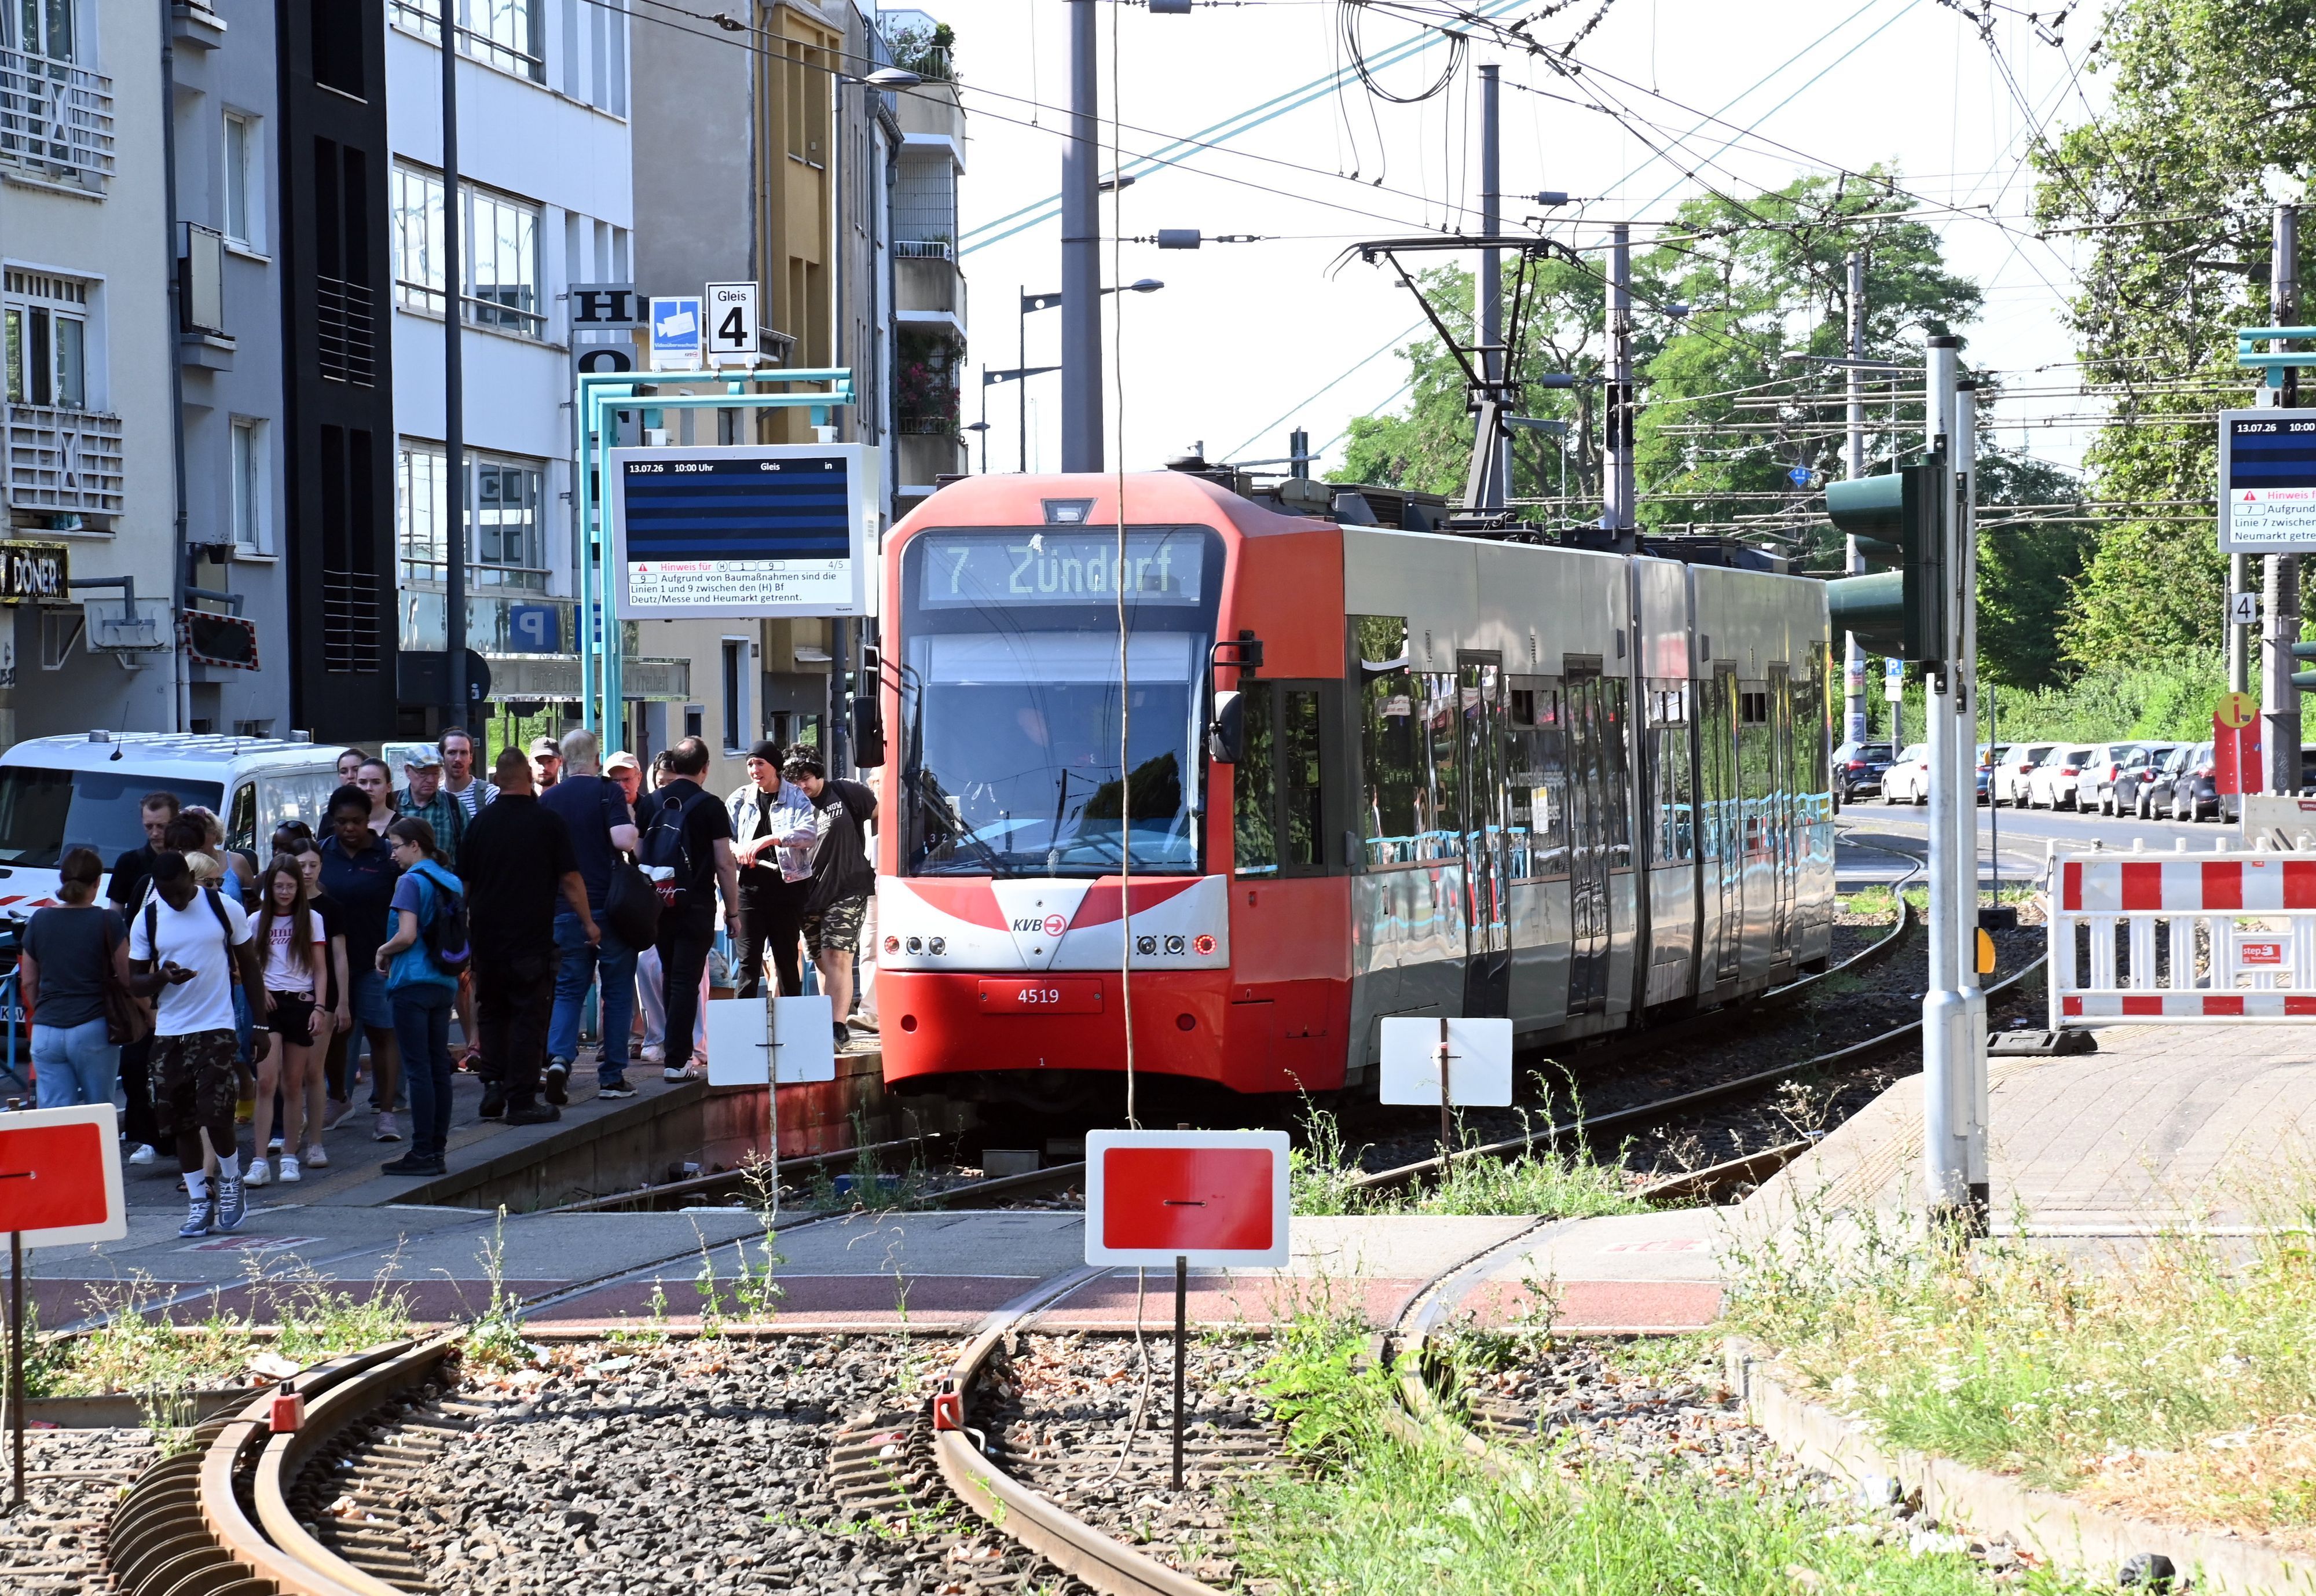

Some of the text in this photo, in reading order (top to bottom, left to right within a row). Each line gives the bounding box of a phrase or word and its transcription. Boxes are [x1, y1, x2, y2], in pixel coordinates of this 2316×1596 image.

[717, 290, 746, 302] Gleis
[719, 307, 747, 347] 4
[2237, 423, 2315, 432] 13.07.26 10:00
[629, 463, 713, 473] 13.07.26 10:00 Uhr
[760, 462, 780, 471] Gleis
[824, 461, 833, 470] in
[2267, 491, 2308, 500] Hinweis
[2247, 504, 2315, 515] 7 Aufgrund
[2235, 518, 2259, 527] Linie
[2263, 518, 2268, 526] 7
[2235, 531, 2286, 540] Neumarkt
[661, 563, 696, 571] Hinweis
[699, 562, 712, 571] für
[741, 563, 745, 571] 1
[768, 562, 774, 571] 9
[828, 560, 844, 570] 4/5
[947, 544, 1172, 594] 7 Zündorf
[640, 575, 646, 584] 9
[661, 574, 703, 584] Aufgrund
[725, 573, 799, 582] Baumaßnahmen
[801, 572, 820, 580] sind
[823, 572, 836, 580] die
[631, 585, 658, 593] Linien
[668, 585, 685, 593] und
[696, 584, 736, 592] zwischen
[739, 584, 756, 592] den
[758, 583, 772, 593] (H)
[775, 583, 784, 591] Bf
[632, 593, 802, 604] Deutz/Messe und Heumarkt getrennt.
[2237, 597, 2251, 618] 4
[1888, 660, 1898, 674] P
[826, 801, 842, 812] NOW
[1012, 919, 1043, 932] KVB
[2243, 947, 2262, 956] step
[1017, 988, 1060, 1003] 4519
[1039, 1057, 1045, 1066] 1
